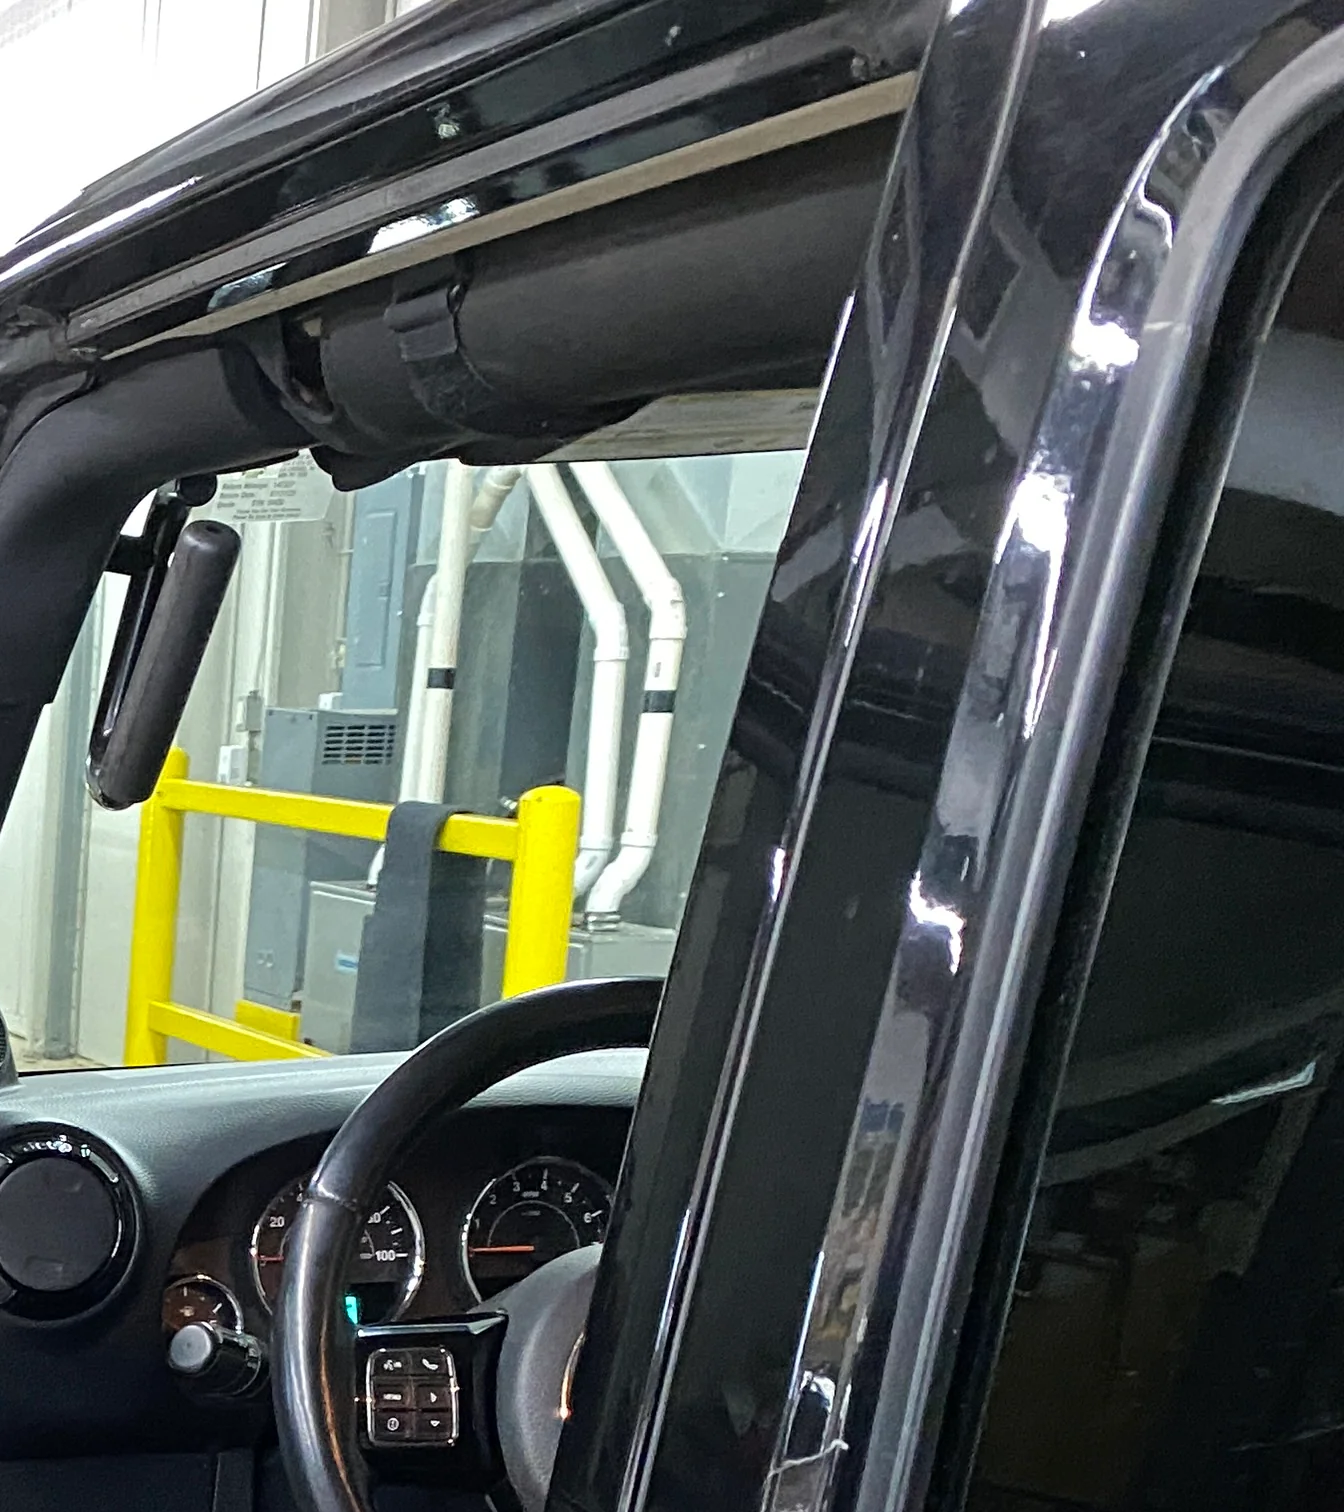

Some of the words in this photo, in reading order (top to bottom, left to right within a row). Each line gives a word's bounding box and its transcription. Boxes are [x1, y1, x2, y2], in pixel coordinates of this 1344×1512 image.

[513, 1181, 520, 1192] 3
[540, 1181, 548, 1191] 4
[489, 1194, 496, 1205] 2
[563, 1192, 572, 1203] 5
[269, 1216, 285, 1228] 20
[583, 1212, 592, 1223] 6
[375, 1249, 396, 1261] 100
